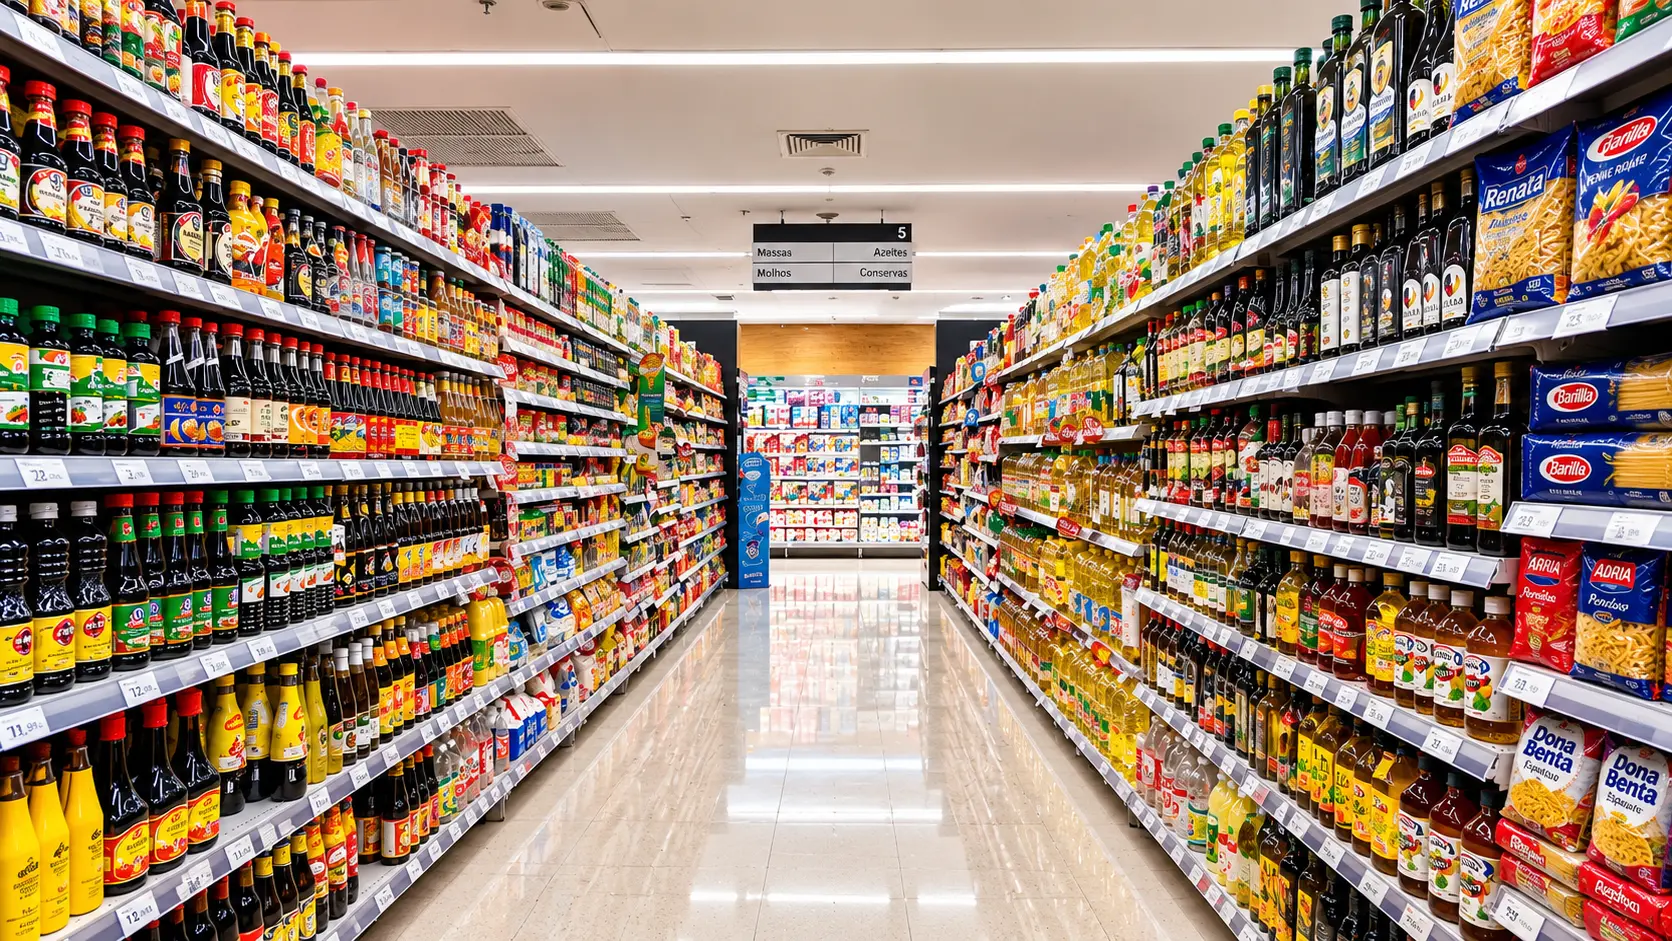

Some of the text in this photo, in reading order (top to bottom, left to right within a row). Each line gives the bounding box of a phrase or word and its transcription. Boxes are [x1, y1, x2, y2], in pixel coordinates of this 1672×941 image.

[1484, 172, 1543, 209] Renata
[897, 226, 906, 239] 5
[757, 248, 792, 257] Massas
[873, 247, 908, 257] Azeites
[757, 268, 792, 278] Molhos
[860, 268, 908, 278] Conservas
[1557, 386, 1593, 404] Barilla
[1550, 460, 1586, 477] Barilla
[1594, 564, 1632, 583] ADRIA
[1532, 724, 1577, 755] Dona
[1522, 739, 1574, 774] Benta
[1613, 753, 1660, 786] Dona
[1604, 768, 1658, 806] Benta
